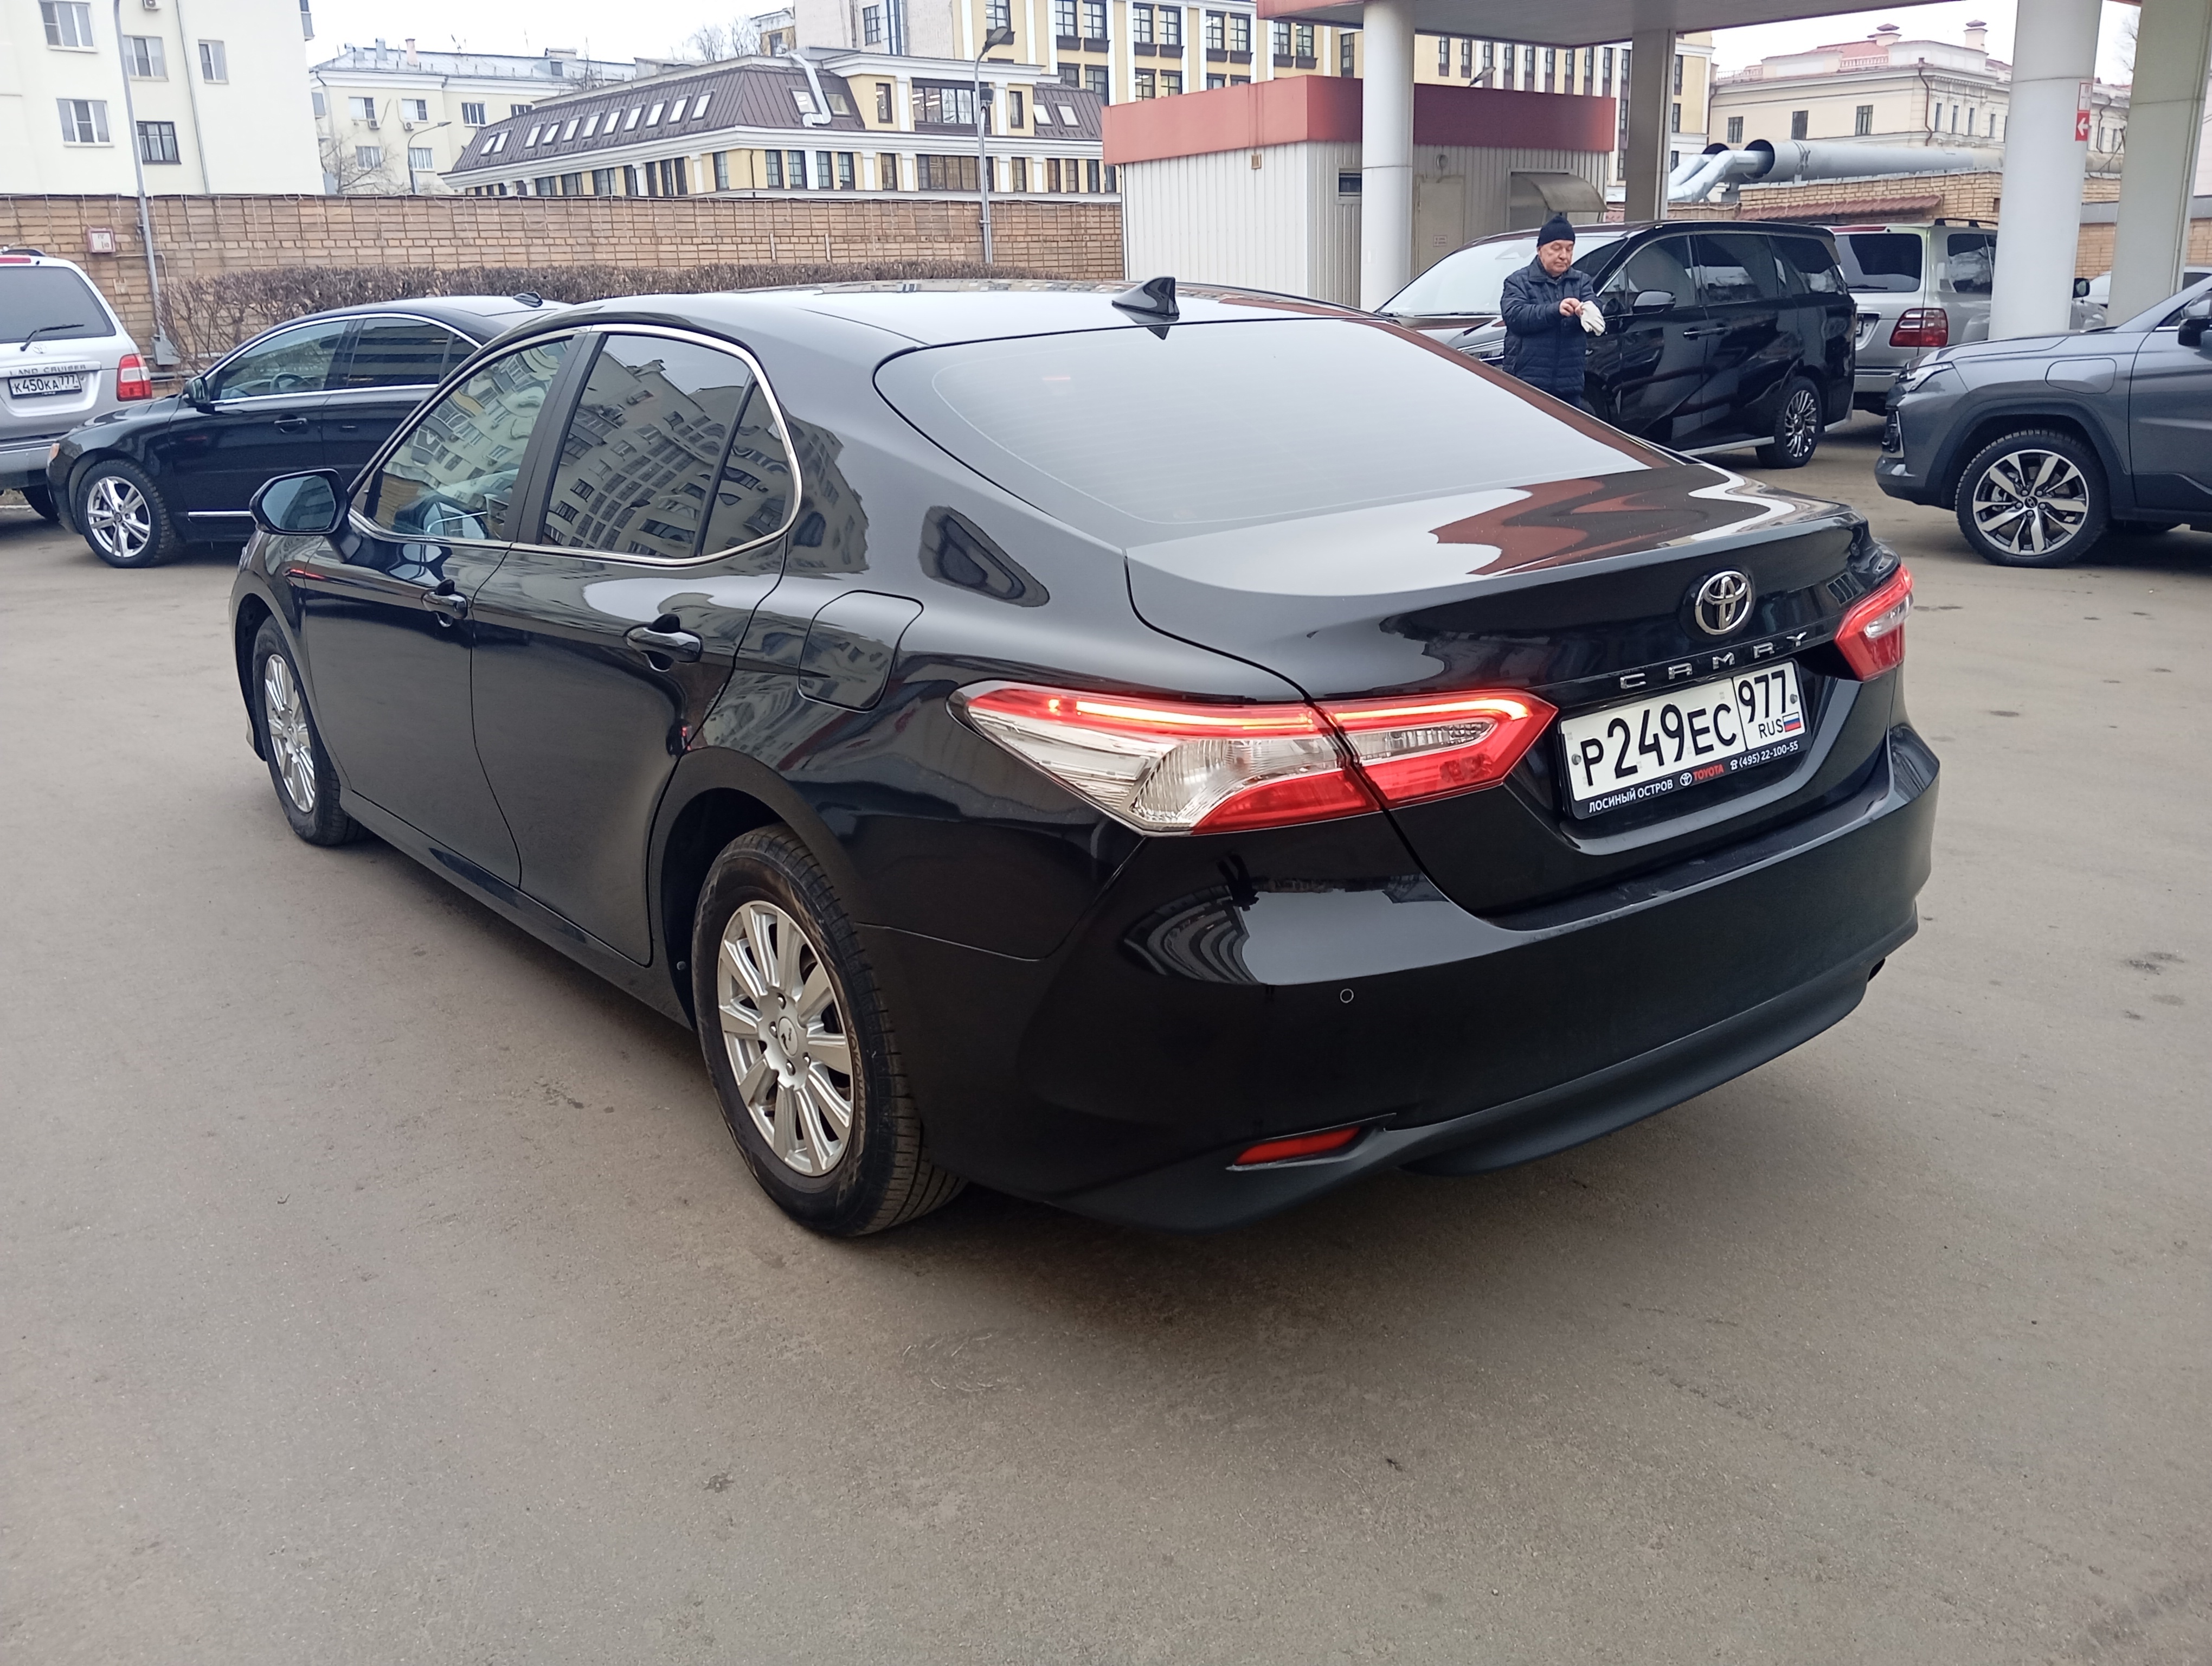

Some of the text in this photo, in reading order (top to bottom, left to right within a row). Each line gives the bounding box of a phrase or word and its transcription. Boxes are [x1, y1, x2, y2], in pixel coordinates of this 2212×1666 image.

[43, 364, 86, 373] CRUISER
[59, 375, 75, 385] 777
[1620, 632, 1807, 689] CAMRY
[1580, 670, 1786, 786] Р249ЕС 977
[1759, 719, 1783, 739] RUS
[1589, 740, 1799, 813] ЛОСИНЫЙ ОСТРОВ TOYOTA (495) 22-100-55
